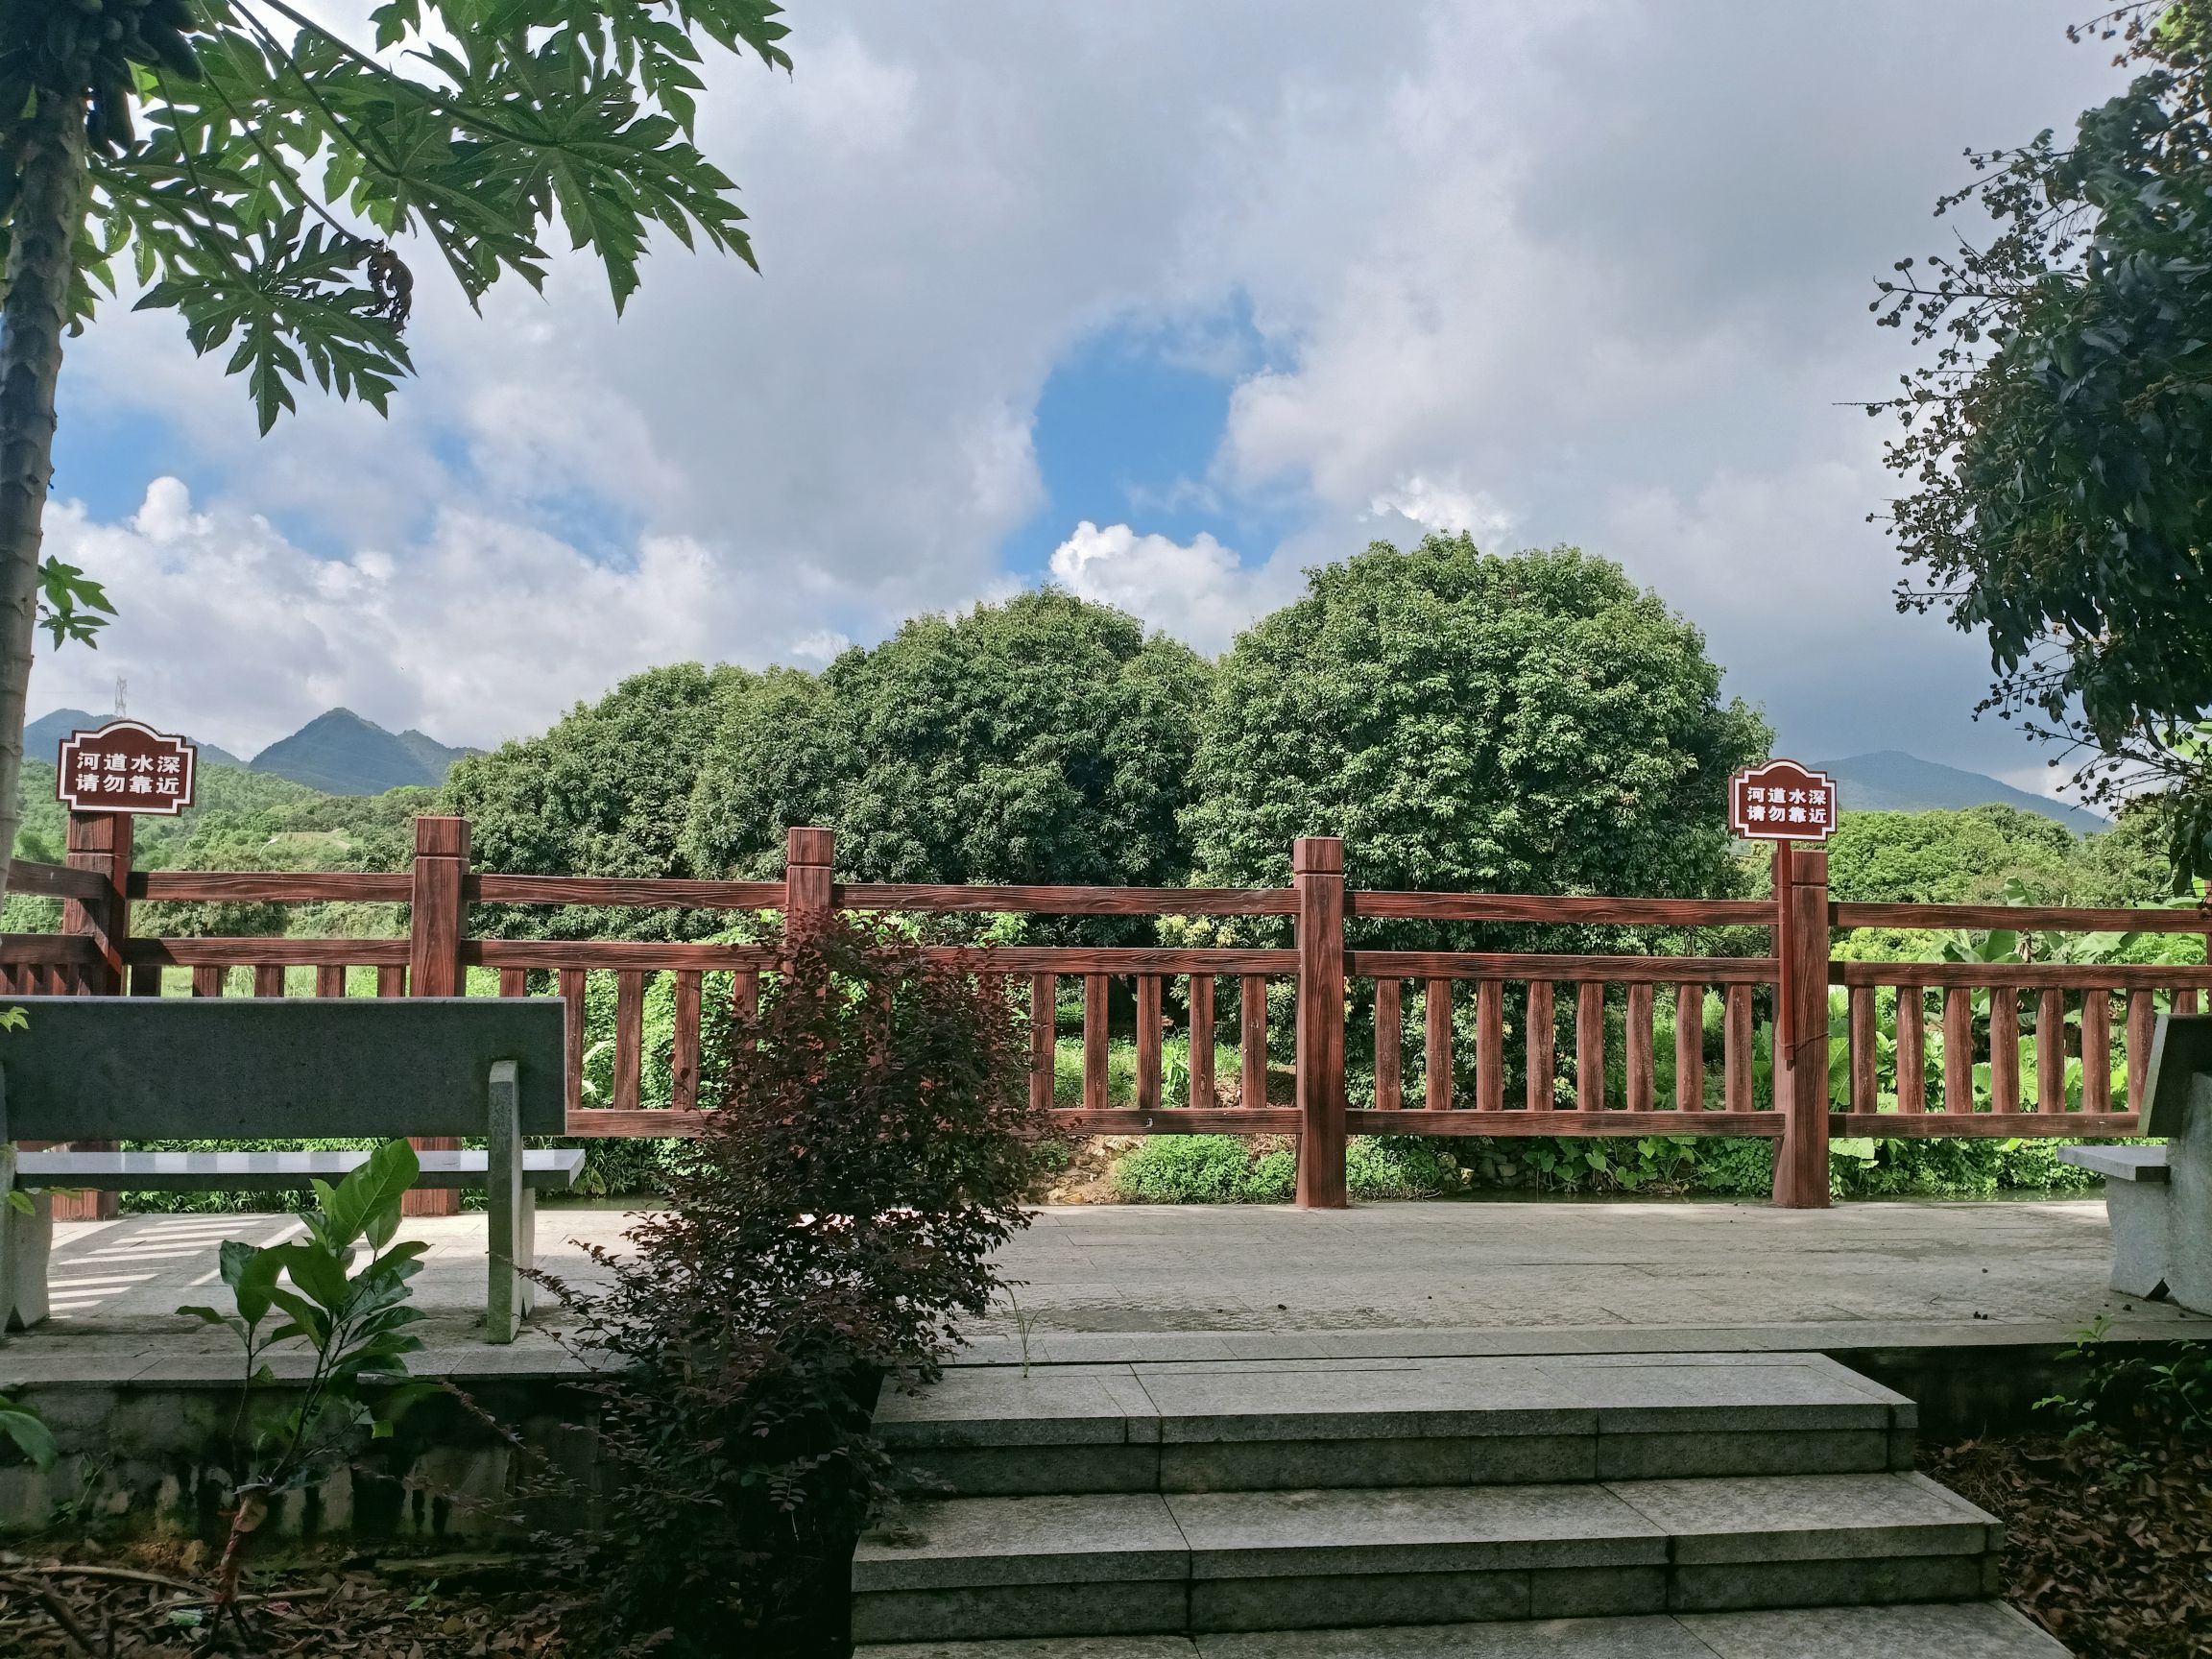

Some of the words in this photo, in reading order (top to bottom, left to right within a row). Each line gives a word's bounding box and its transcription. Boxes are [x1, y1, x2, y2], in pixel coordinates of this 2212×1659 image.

[77, 752, 180, 774] 河道水深
[75, 773, 180, 795] 请勿靠近
[1747, 786, 1826, 805] 河道水深
[1746, 805, 1827, 824] 请勿靠近
